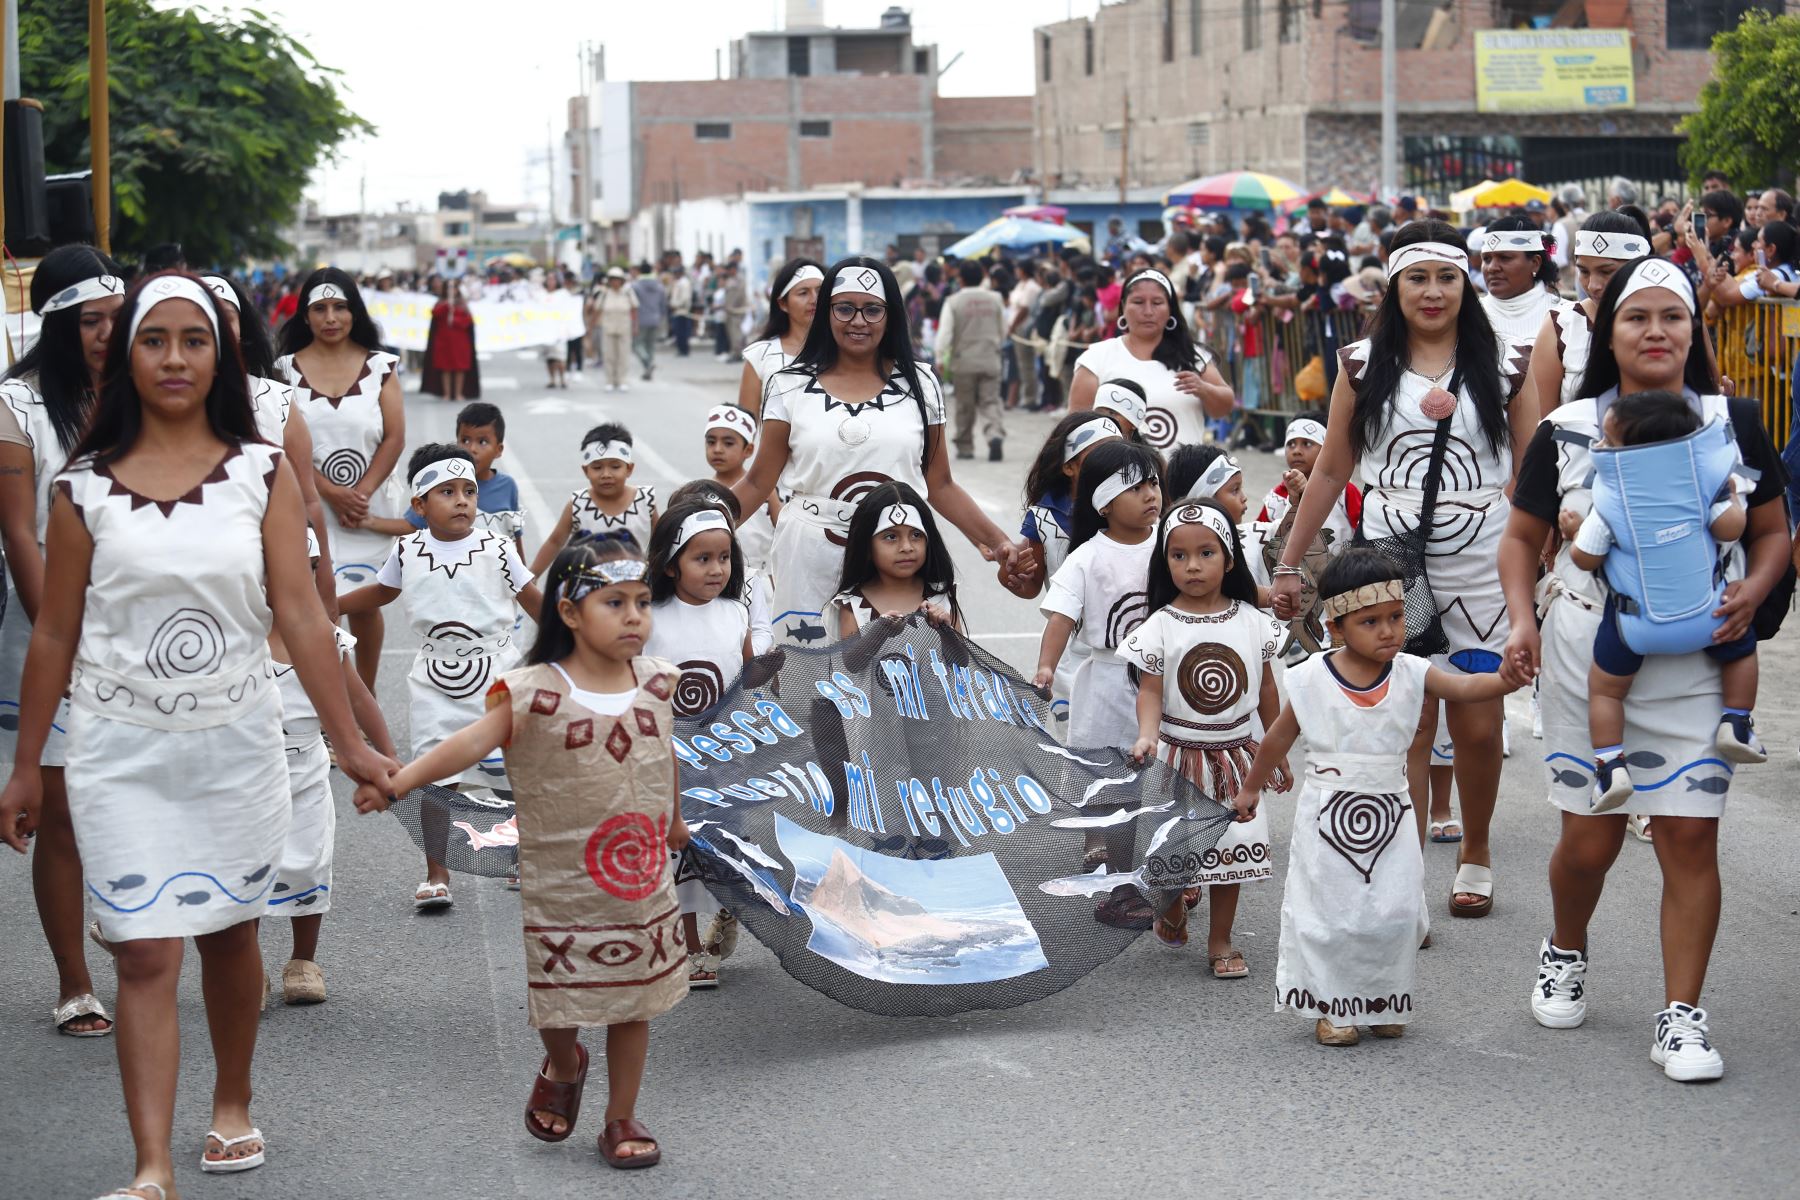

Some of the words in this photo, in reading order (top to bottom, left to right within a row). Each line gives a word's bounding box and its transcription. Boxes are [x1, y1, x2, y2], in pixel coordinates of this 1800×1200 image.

[815, 671, 871, 719] es
[880, 643, 929, 720] mi
[930, 649, 1045, 731] terapia
[844, 750, 886, 834] mi
[896, 767, 1051, 847] refugio
